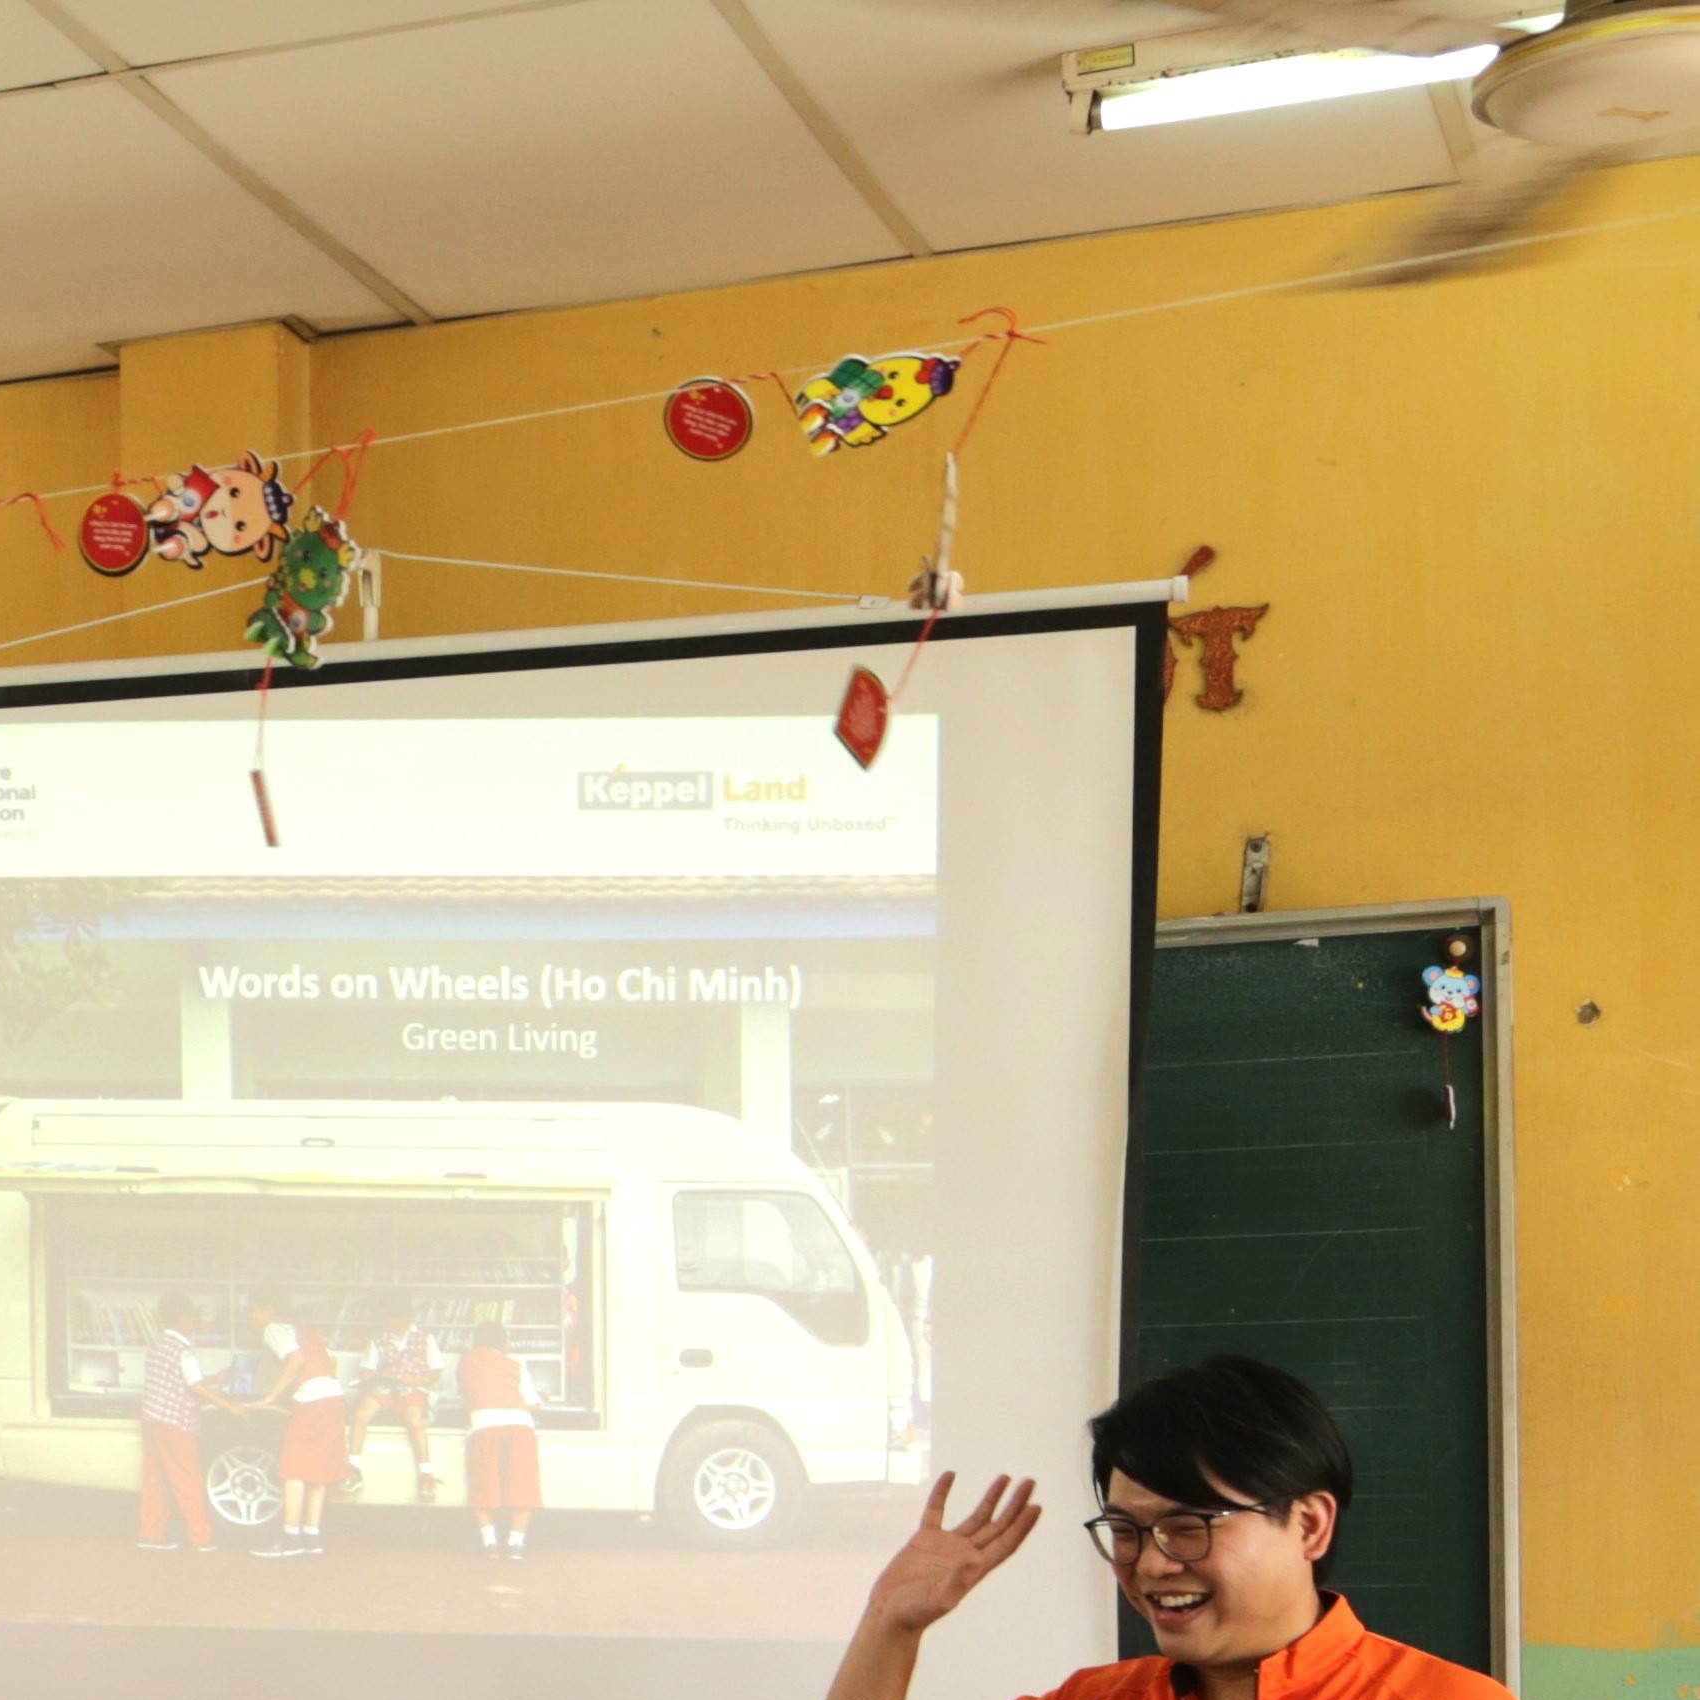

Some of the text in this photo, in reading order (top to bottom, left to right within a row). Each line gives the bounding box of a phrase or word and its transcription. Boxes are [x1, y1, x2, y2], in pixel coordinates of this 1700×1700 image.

[722, 774, 807, 802] Land
[722, 817, 801, 834] Thinking
[199, 964, 801, 1009] Words on Wheels (Ho Chi Minh)
[401, 1021, 598, 1059] Green Living
